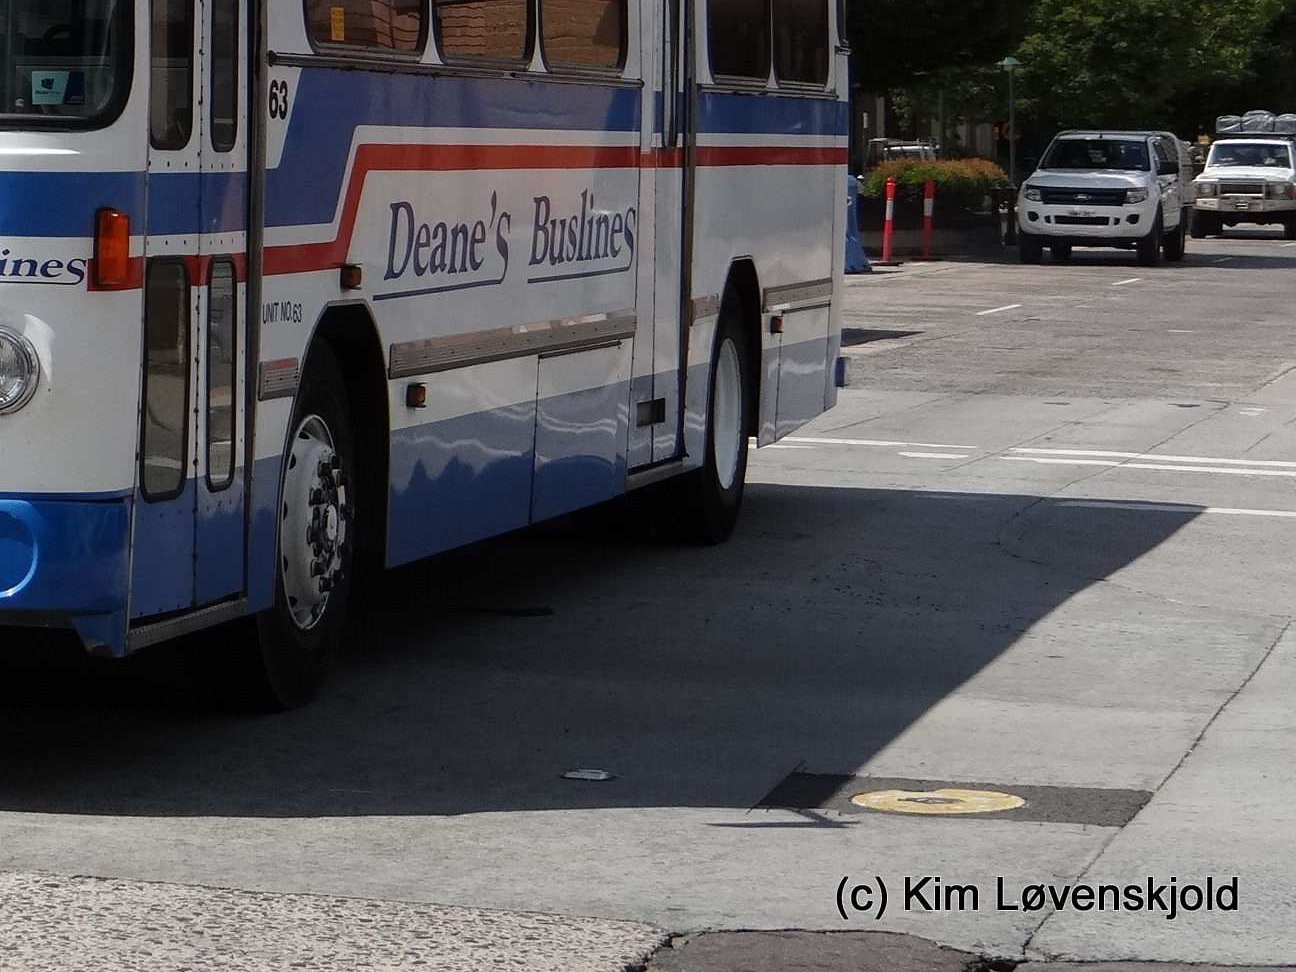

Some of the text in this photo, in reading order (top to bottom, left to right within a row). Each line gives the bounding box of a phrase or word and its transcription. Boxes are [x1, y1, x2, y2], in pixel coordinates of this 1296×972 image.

[269, 79, 288, 120] 63
[383, 188, 637, 285] Deane's Buslines
[262, 302, 279, 324] UNIT
